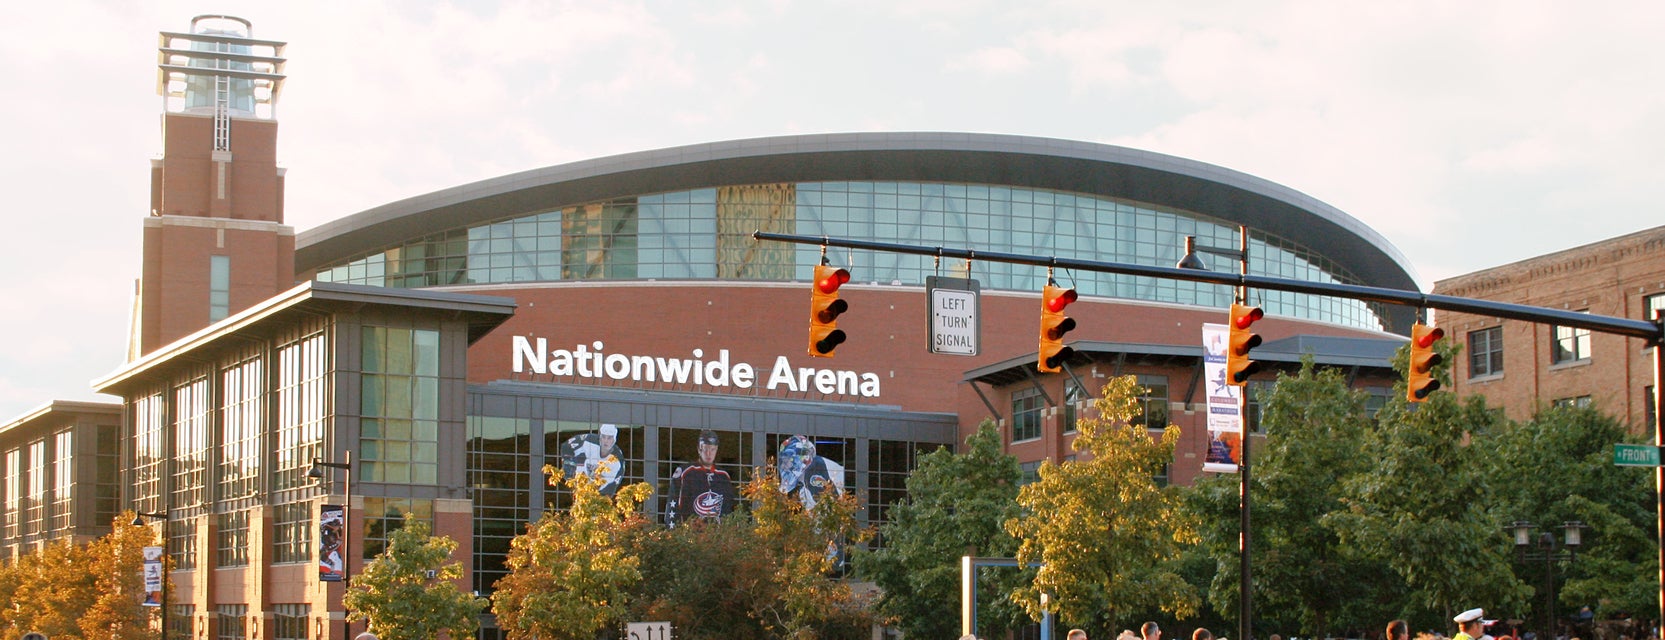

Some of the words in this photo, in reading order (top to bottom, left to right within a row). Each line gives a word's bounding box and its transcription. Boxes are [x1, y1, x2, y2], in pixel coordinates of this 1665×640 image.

[942, 297, 966, 310] LEFT
[941, 315, 968, 328] TURN
[936, 333, 973, 347] SIGNAL
[512, 335, 754, 388] Nationwide
[767, 355, 880, 397] Arena
[1622, 448, 1650, 462] FRONT
